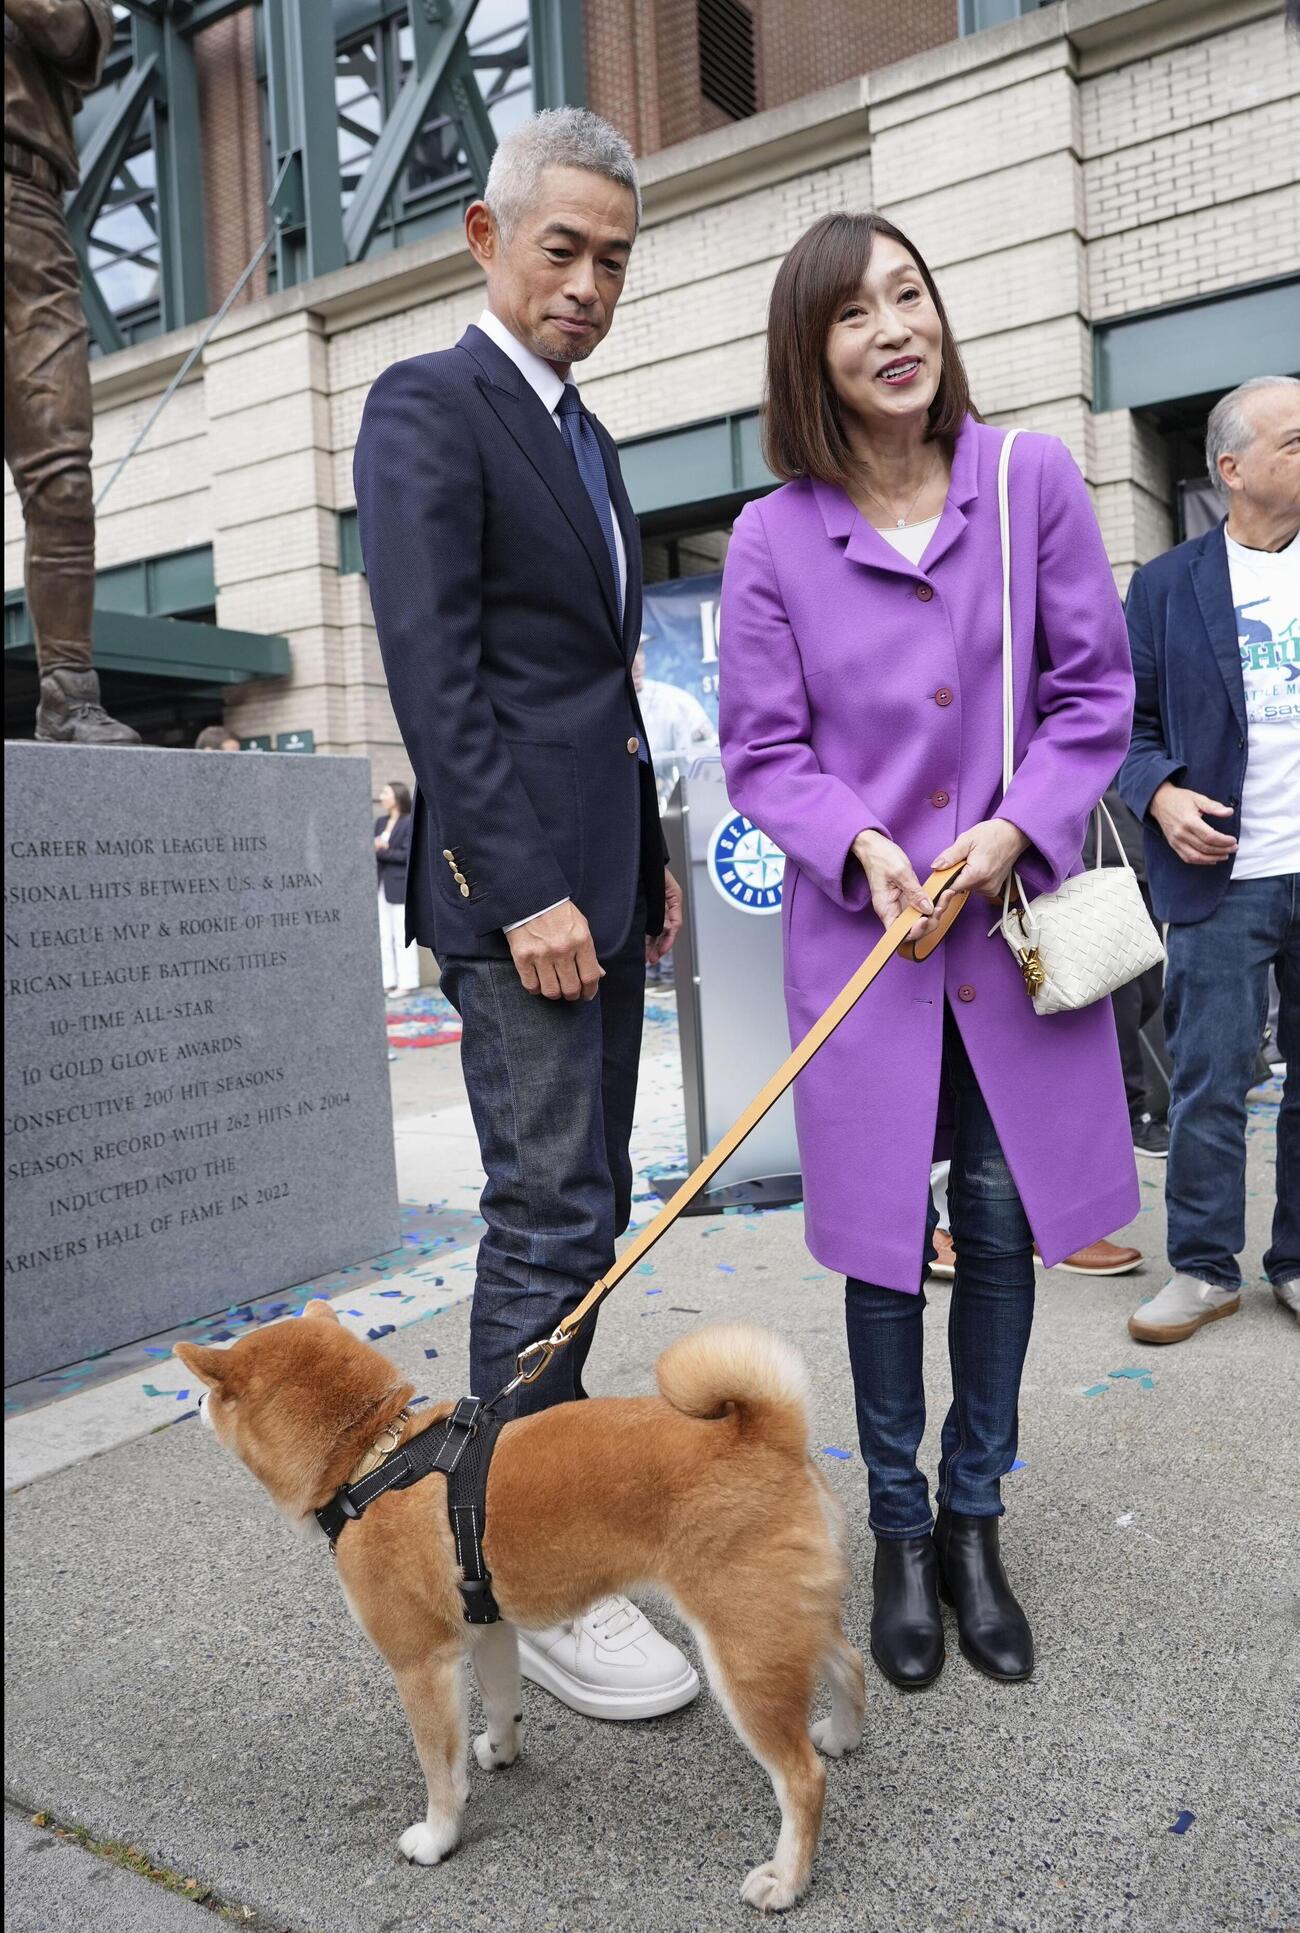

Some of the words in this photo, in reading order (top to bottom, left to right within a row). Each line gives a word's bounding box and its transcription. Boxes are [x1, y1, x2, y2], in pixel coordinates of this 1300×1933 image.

[701, 601, 720, 664] I
[11, 840, 87, 858] CAREER
[96, 838, 155, 857] MAJOR
[162, 837, 225, 854] LEAGUE
[232, 836, 268, 851] HITS
[5, 884, 82, 904] SIONAL
[89, 881, 131, 899] HITS
[140, 878, 220, 896] BETWEEN
[226, 876, 256, 892] U.S.
[262, 875, 273, 890] &
[280, 872, 323, 892] JAPAN
[30, 927, 105, 948] LEAGUE
[113, 923, 151, 941] MVP
[158, 921, 171, 937] &
[179, 916, 239, 935] ROOKIE
[245, 914, 265, 930] OF
[270, 912, 300, 928] THE
[304, 909, 342, 925] YEAR
[5, 973, 72, 996] RICAN
[81, 965, 151, 988] LEAGUE
[160, 957, 231, 979] BATTING
[237, 951, 288, 970] TITLES
[50, 1010, 126, 1036] 10-TIME
[133, 999, 214, 1025] ALL-STAR
[22, 1067, 41, 1086] 10
[50, 1057, 104, 1081] GOLD
[111, 1047, 169, 1071] GLOVE
[175, 1034, 243, 1060] AWARDS
[143, 1087, 174, 1108] 200
[180, 1081, 210, 1101] HIT
[216, 1067, 285, 1094] SEASONS
[8, 1150, 84, 1181] SEASON
[93, 1131, 166, 1162] RECORD
[171, 1119, 219, 1142] WITH
[226, 1113, 251, 1132] 262
[257, 1103, 292, 1125] HITS
[298, 1100, 313, 1116] IN
[319, 1092, 350, 1111] 2004
[50, 1178, 148, 1217] INDUCTED
[156, 1166, 197, 1190] INTO
[204, 1156, 236, 1177] THE
[96, 1223, 144, 1249] HALL
[150, 1214, 173, 1234] OF
[180, 1200, 225, 1226] FAME
[231, 1193, 248, 1211] IN
[255, 1182, 290, 1205] 2022
